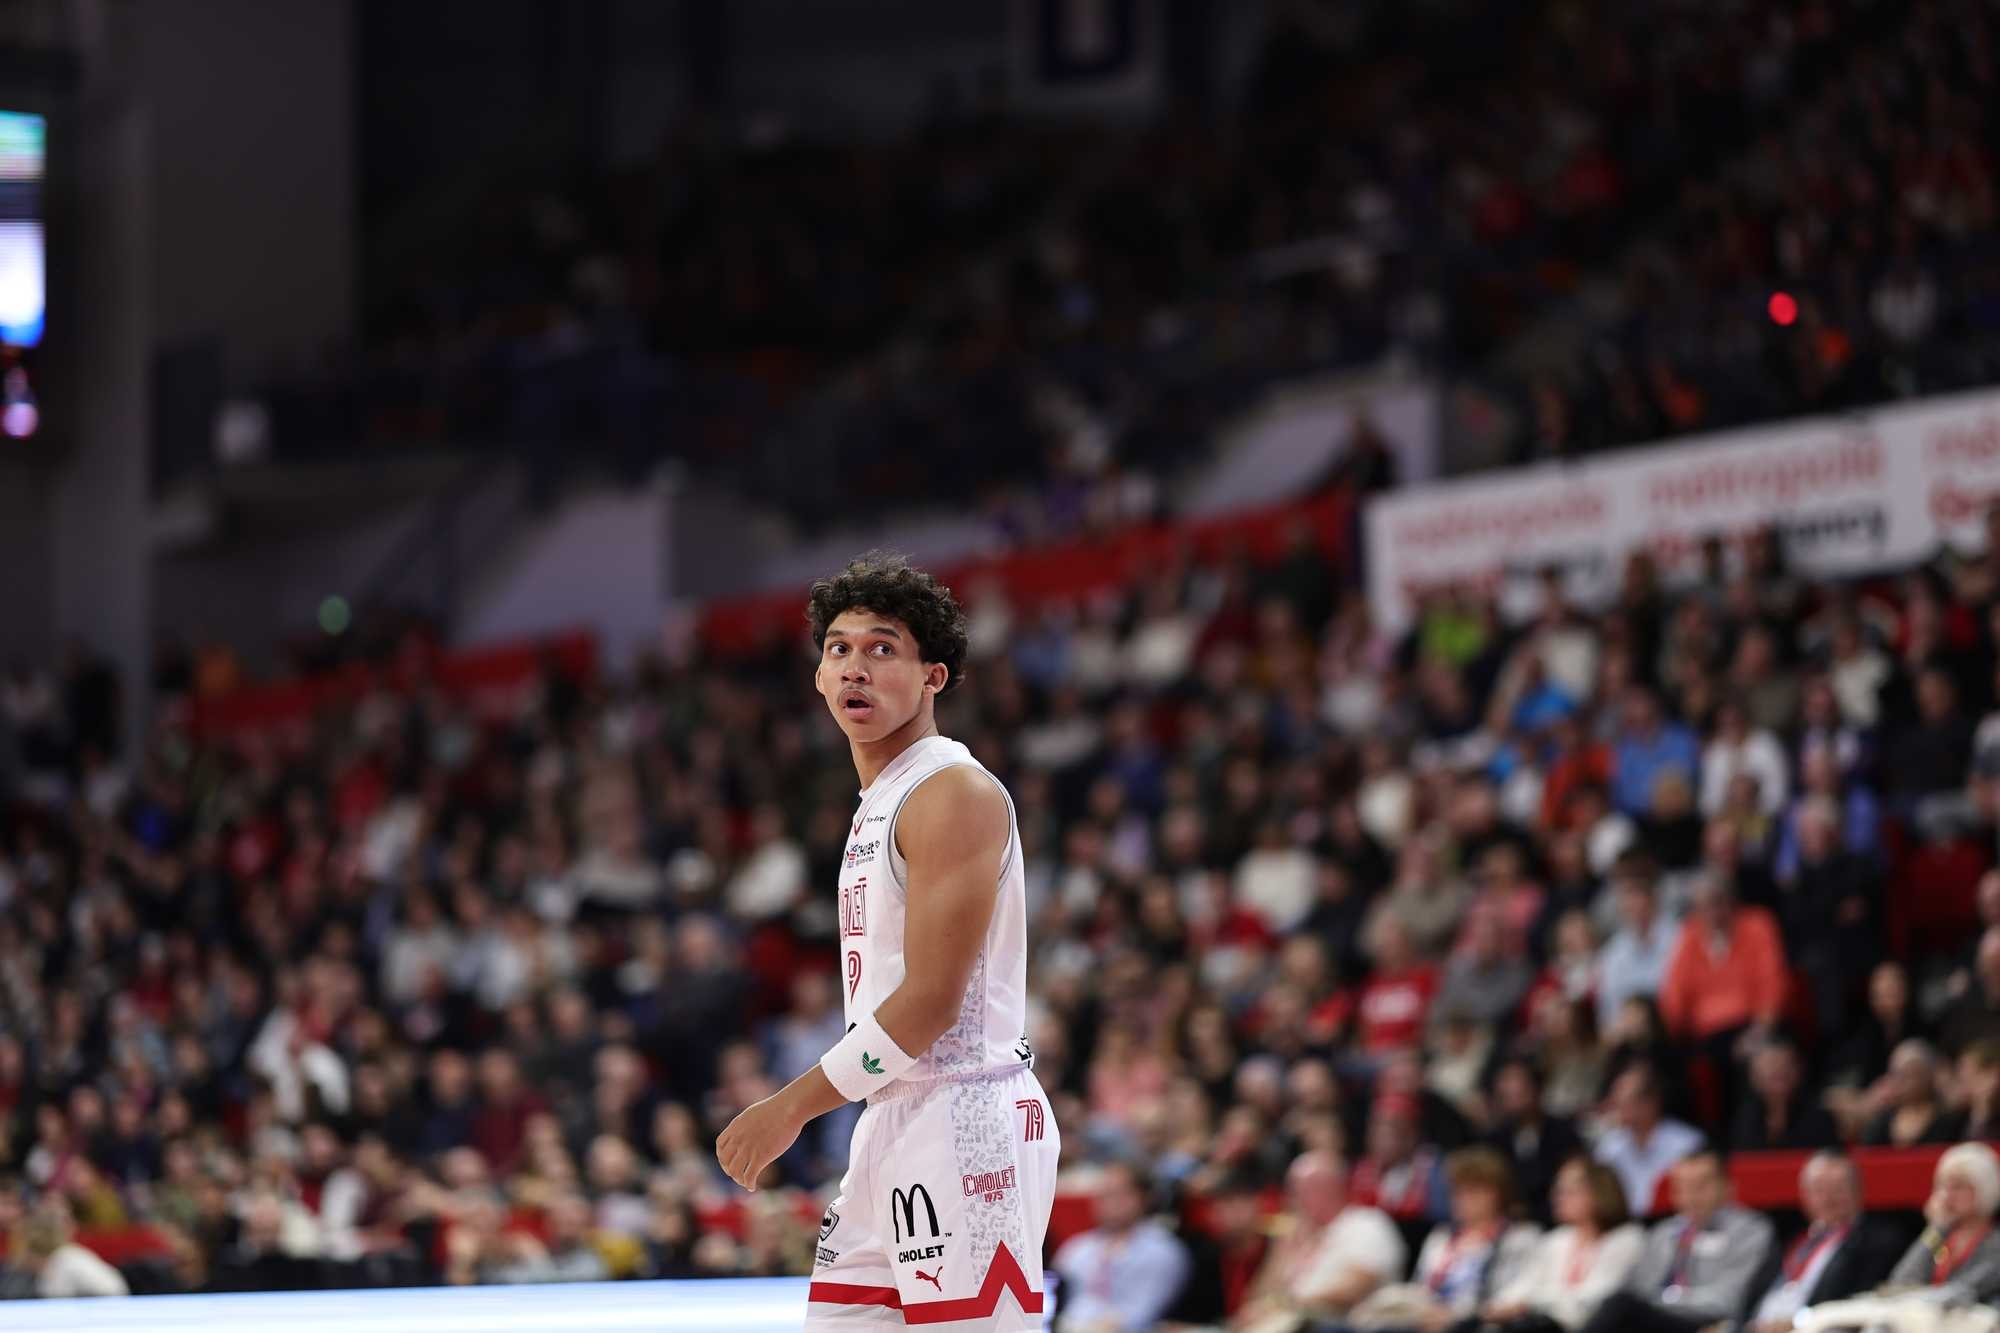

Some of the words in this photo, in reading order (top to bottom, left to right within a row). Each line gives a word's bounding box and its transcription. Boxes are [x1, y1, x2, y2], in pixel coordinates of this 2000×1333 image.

[1016, 1098, 1044, 1142] 79
[962, 1165, 1017, 1197] CHOLET
[984, 1190, 1004, 1203] 1975
[898, 1244, 945, 1264] CHOLET
